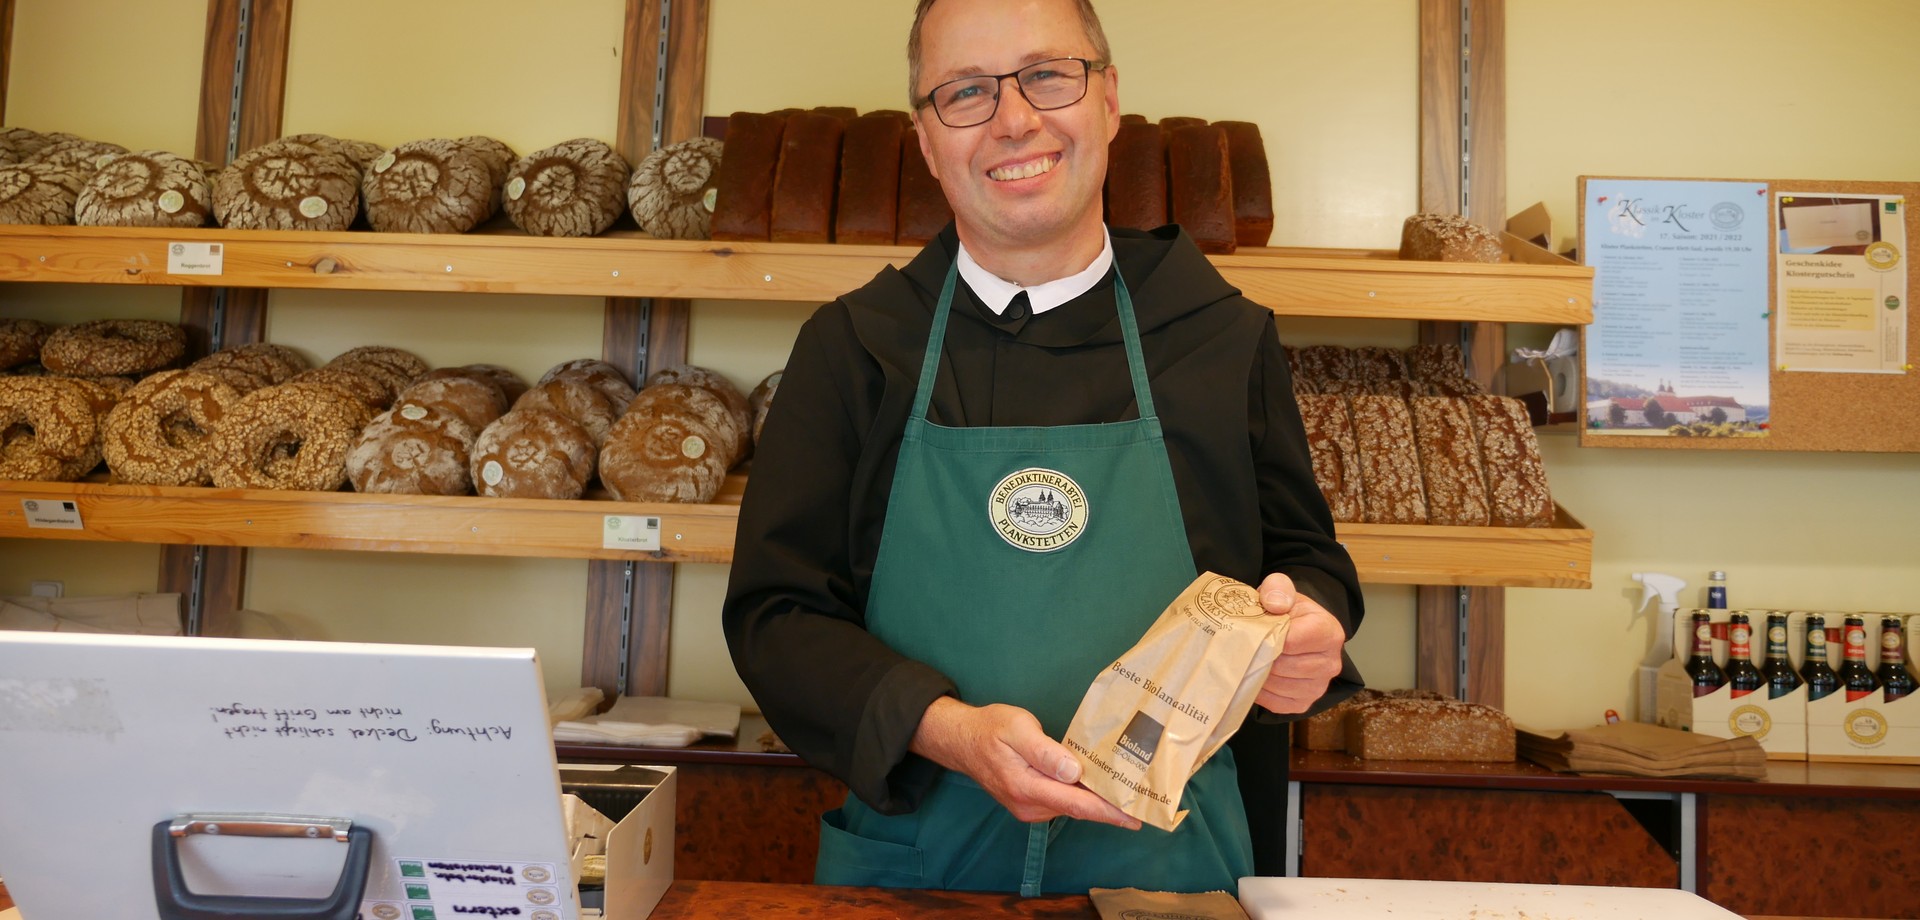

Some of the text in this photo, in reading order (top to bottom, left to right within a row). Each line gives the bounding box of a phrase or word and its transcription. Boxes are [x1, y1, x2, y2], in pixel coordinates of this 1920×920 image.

[1724, 234, 1743, 242] 2022
[1785, 260, 1843, 268] Geschenkidee
[1786, 271, 1855, 279] Klostergutschein
[995, 473, 1082, 508] BENEDIKTINERABTEI
[998, 518, 1079, 547] PLANKSTETTEN
[1111, 661, 1141, 685] Beste
[274, 707, 317, 720] Griff
[326, 708, 351, 717] am
[360, 706, 403, 718] nicht
[225, 724, 267, 739] nicht
[348, 727, 418, 742] Deckel
[428, 718, 512, 741] Achtung:
[1119, 734, 1153, 761] Bioland
[453, 904, 521, 918] extern
